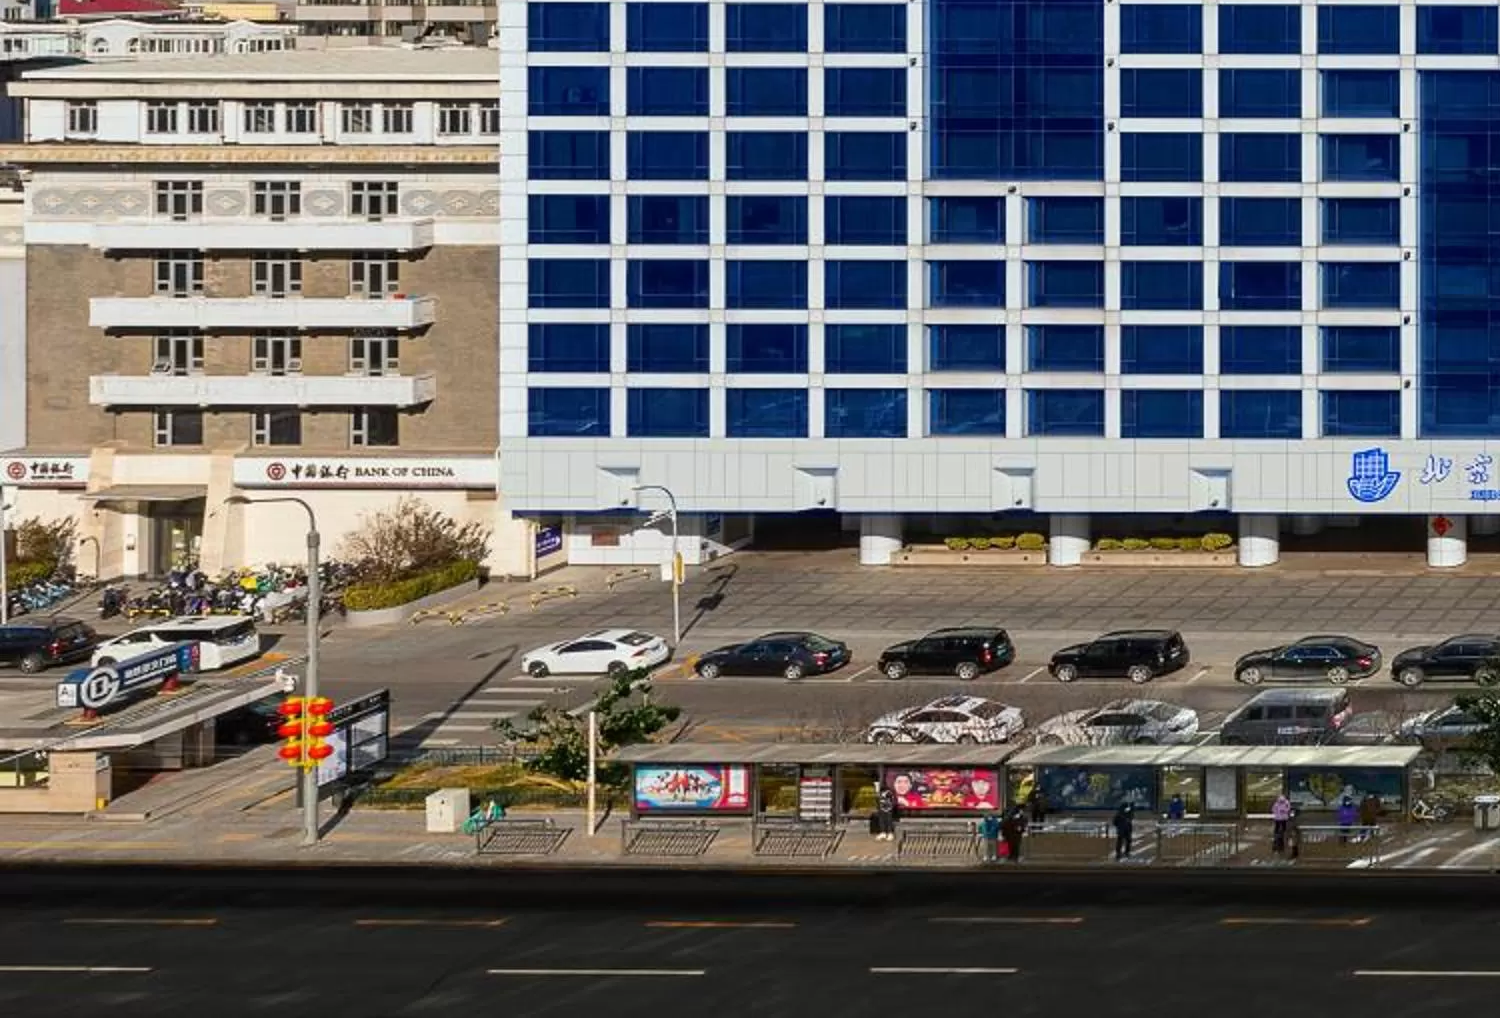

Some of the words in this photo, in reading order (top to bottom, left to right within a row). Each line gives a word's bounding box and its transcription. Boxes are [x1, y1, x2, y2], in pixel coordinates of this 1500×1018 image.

[292, 463, 350, 480] 中国银行
[355, 467, 389, 477] BANK
[391, 467, 408, 477] OF
[412, 467, 455, 477] CHINA
